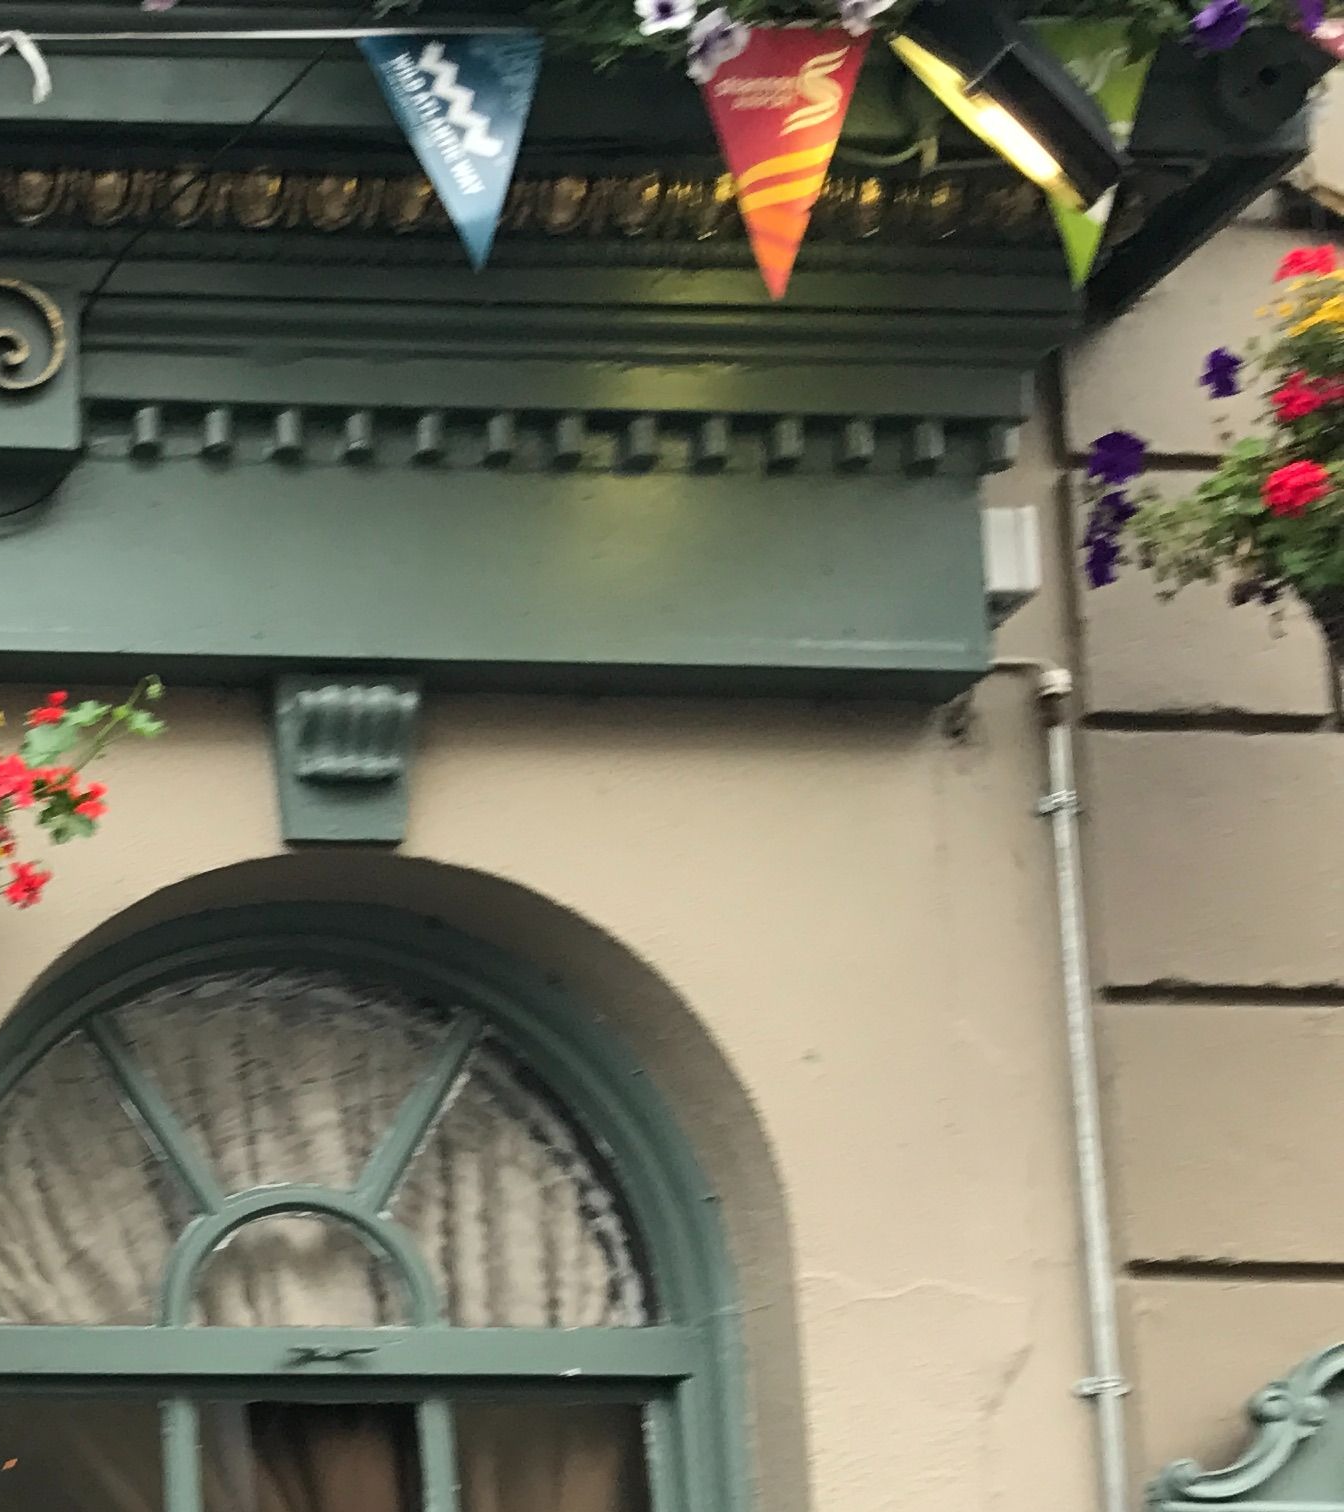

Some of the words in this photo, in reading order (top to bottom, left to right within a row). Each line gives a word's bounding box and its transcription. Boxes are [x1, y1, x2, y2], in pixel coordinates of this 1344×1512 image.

[388, 51, 427, 93] WILD
[410, 91, 465, 164] ATLANTIC
[450, 158, 486, 195] WAY
